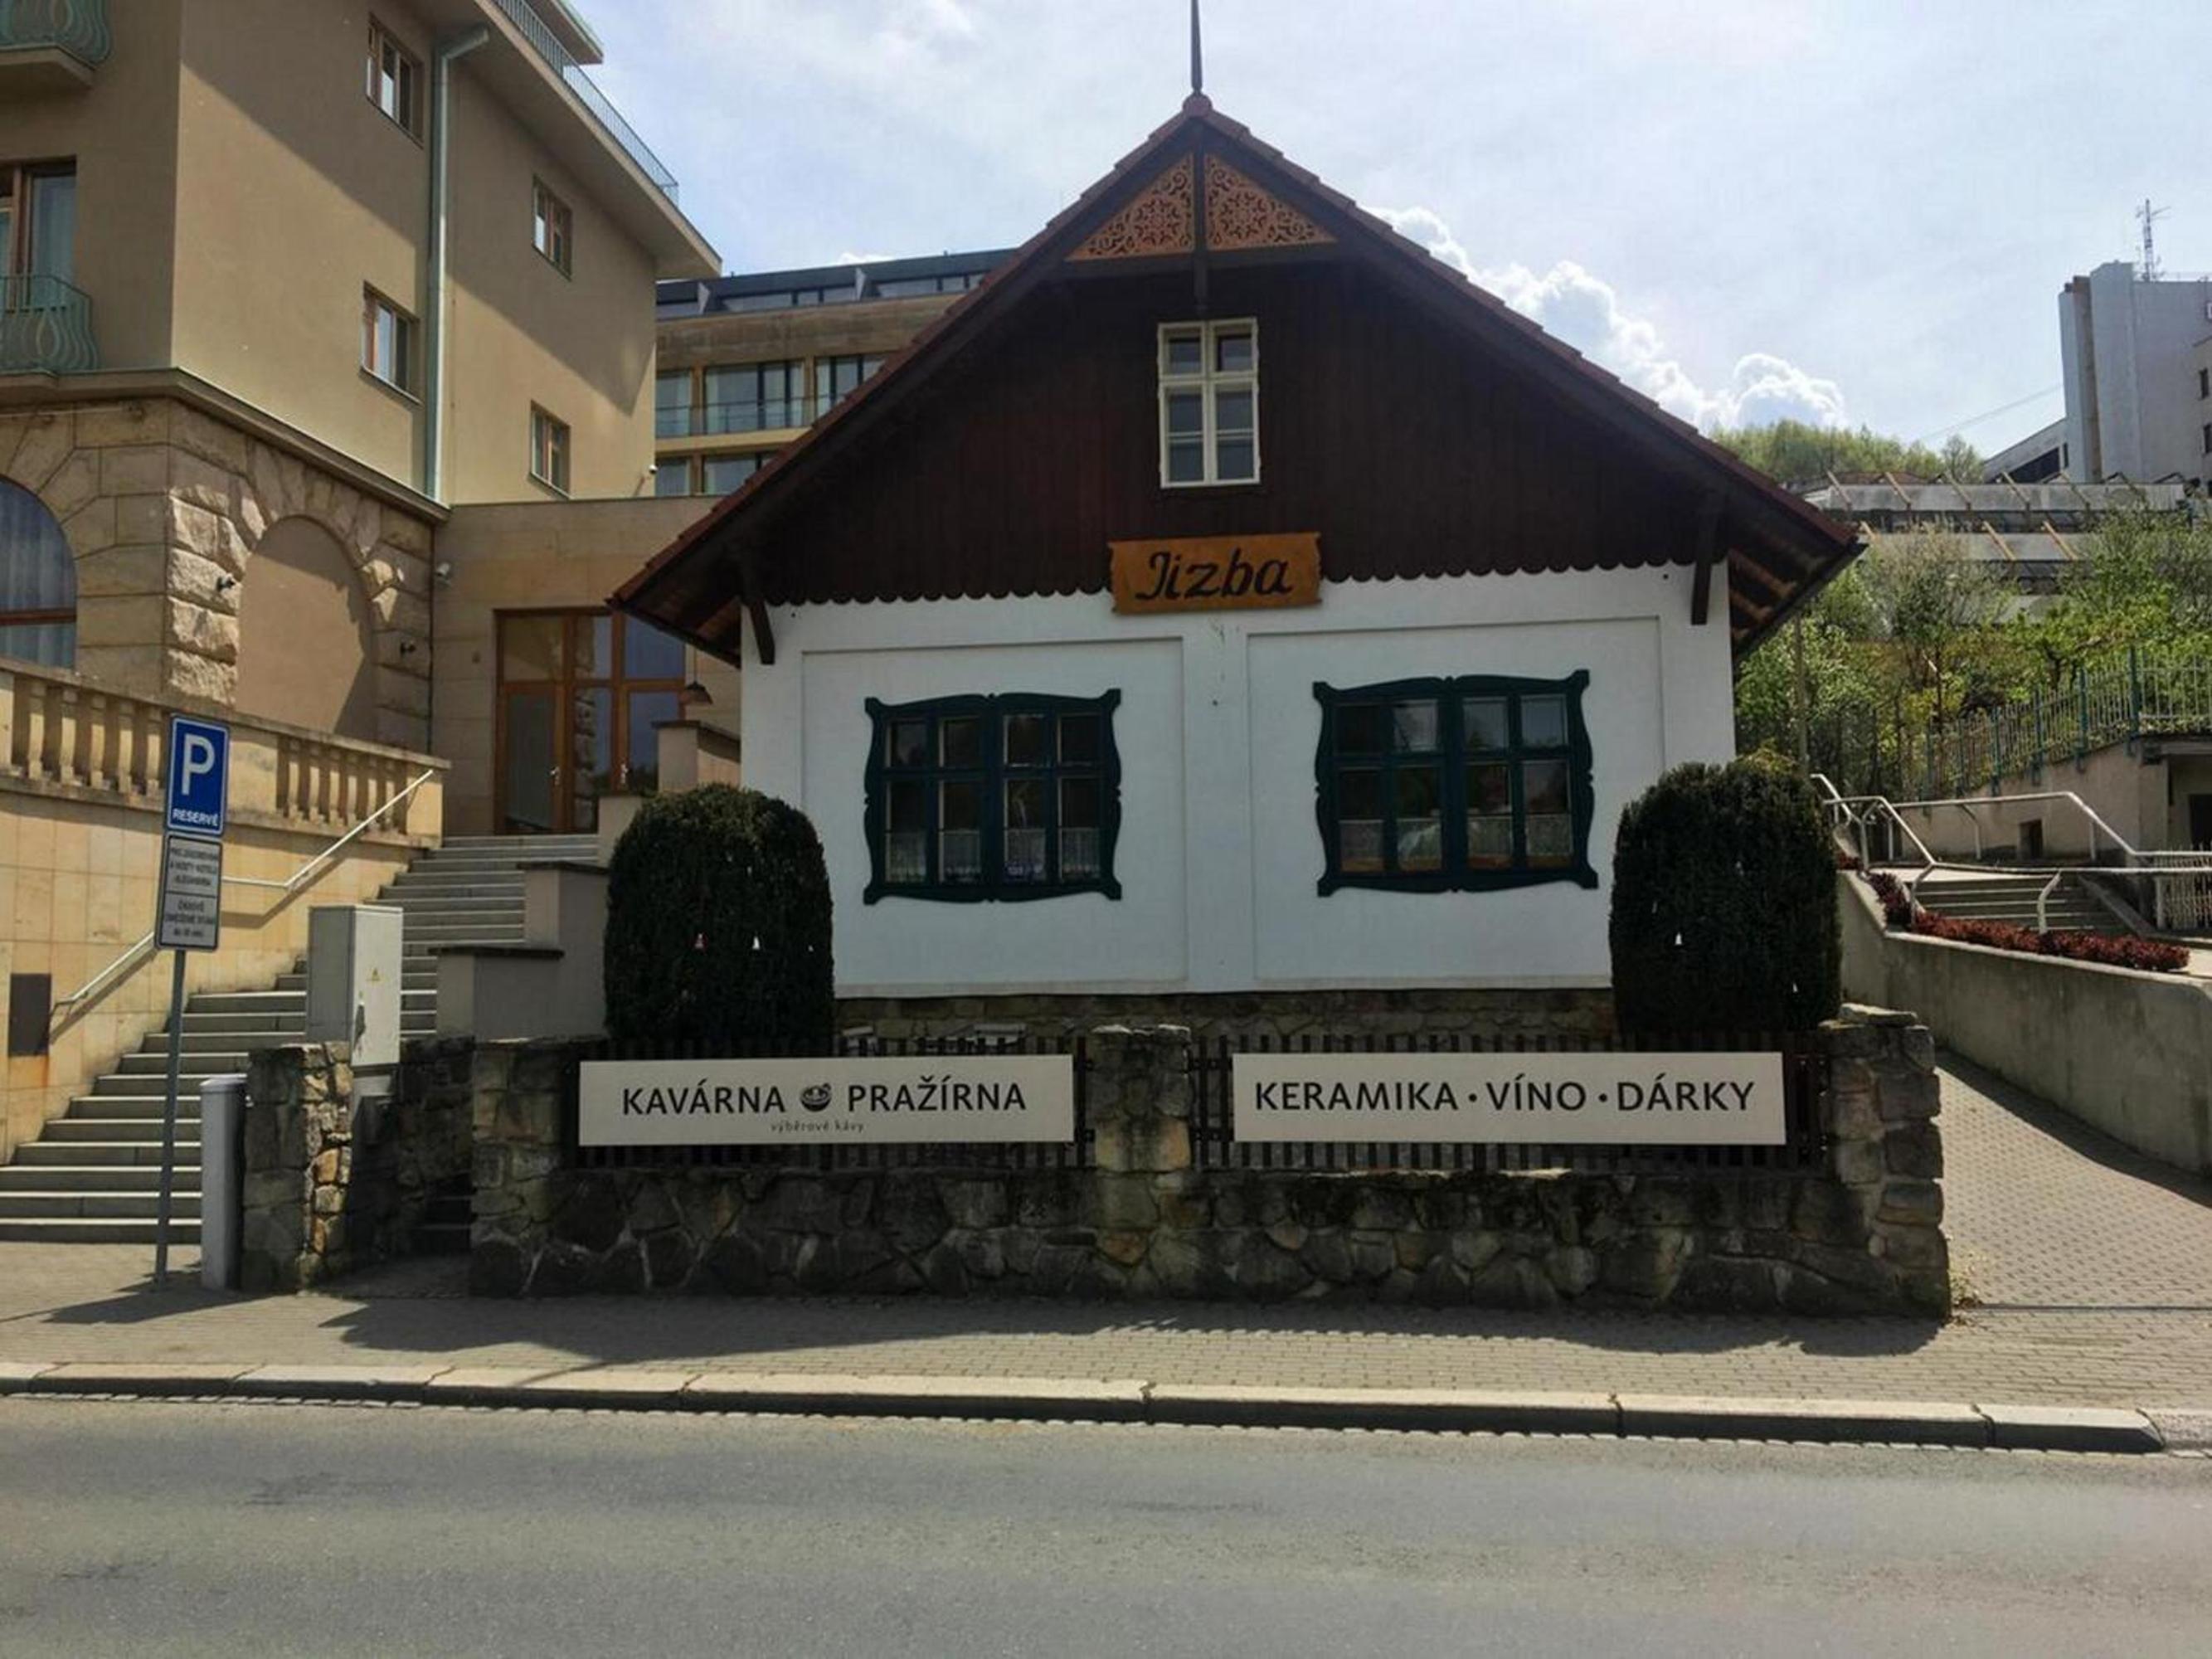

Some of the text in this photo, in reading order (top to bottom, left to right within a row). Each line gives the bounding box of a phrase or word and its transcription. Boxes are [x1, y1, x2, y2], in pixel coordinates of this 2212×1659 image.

[1135, 547, 1294, 601] Jizba
[181, 732, 215, 795] P
[622, 1075, 1027, 1115] KAVÁRNA PRAŽÍRNA
[1255, 1073, 1755, 1112] KERAMIKA VÍNO DÁRKY
[834, 1119, 864, 1133] kávy
